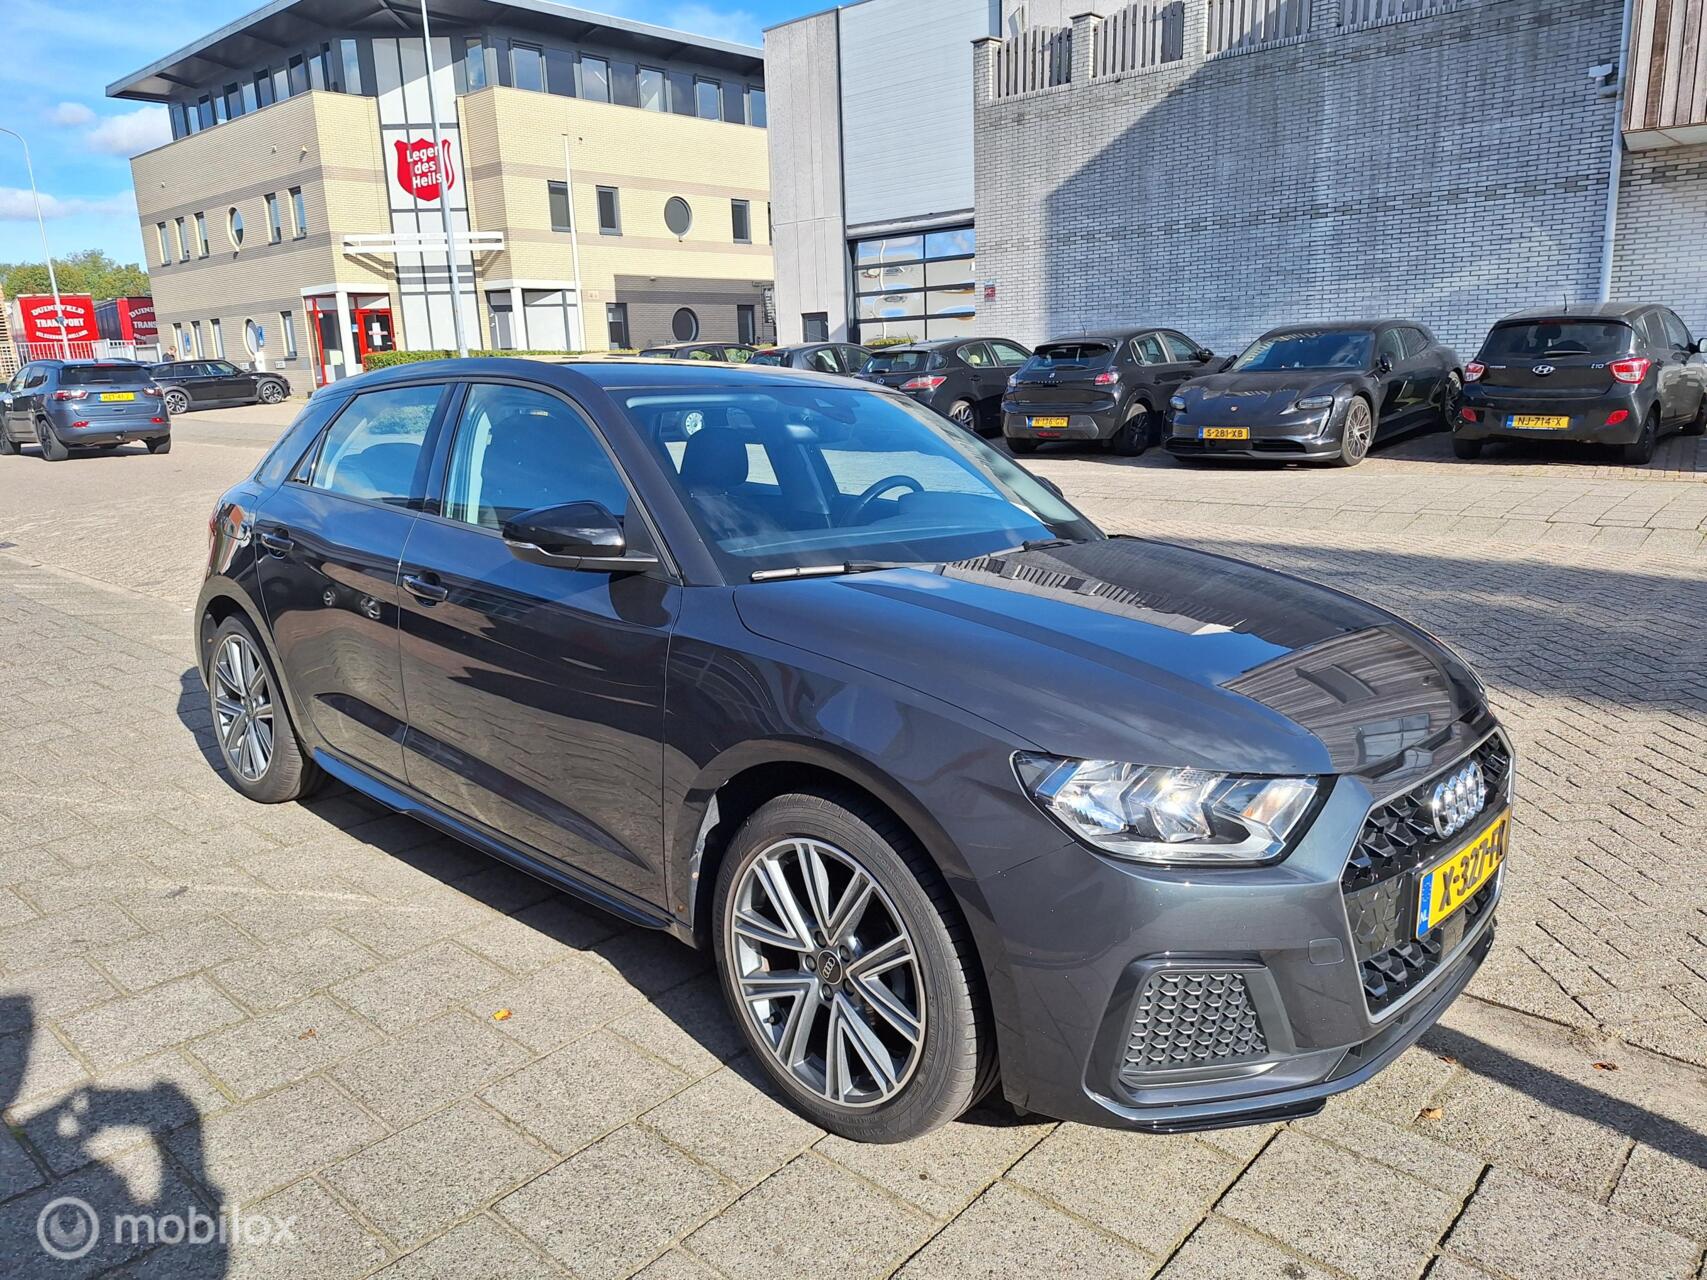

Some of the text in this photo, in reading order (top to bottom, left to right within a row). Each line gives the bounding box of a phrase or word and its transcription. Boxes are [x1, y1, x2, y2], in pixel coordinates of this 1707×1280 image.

[406, 146, 438, 162] Leger
[414, 161, 436, 174] des
[412, 172, 442, 189] Heils
[35, 318, 84, 328] TRANPORT
[1517, 416, 1562, 426] NJ-714-X
[1207, 429, 1244, 437] S-281-XB
